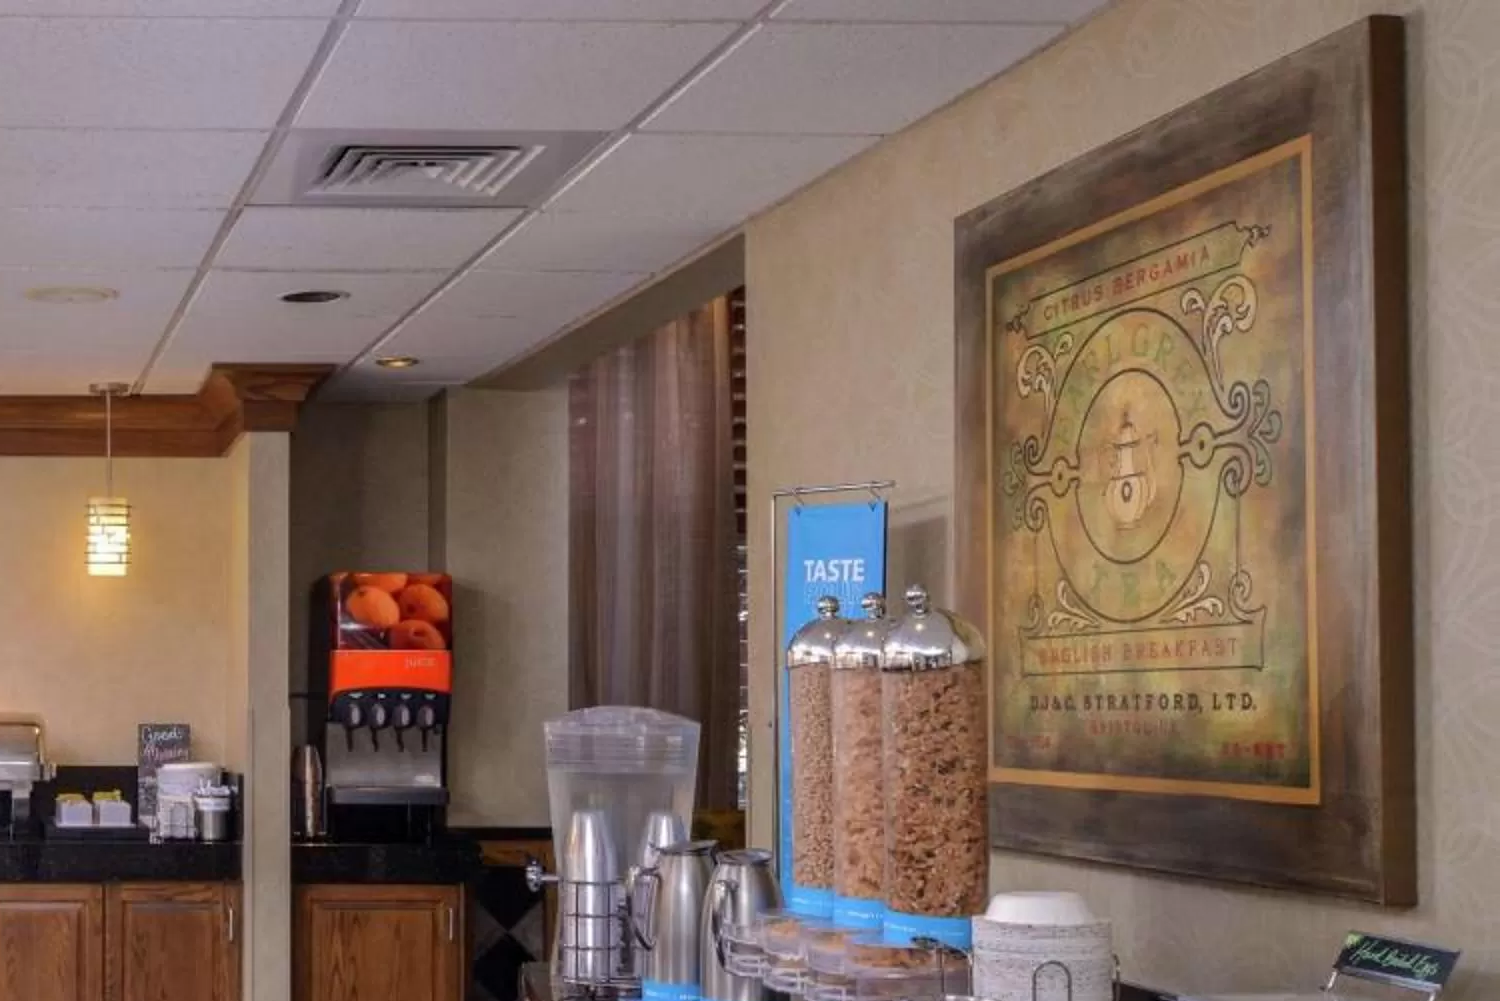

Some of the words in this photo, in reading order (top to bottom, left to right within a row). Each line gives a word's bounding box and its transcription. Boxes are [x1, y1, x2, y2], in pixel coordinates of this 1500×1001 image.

[1043, 286, 1104, 321] CITRUS
[1112, 245, 1211, 296] BERGAMIA
[803, 559, 865, 581] TASTE
[1123, 637, 1238, 662] BREAKFAST
[1212, 691, 1258, 711] LTD.
